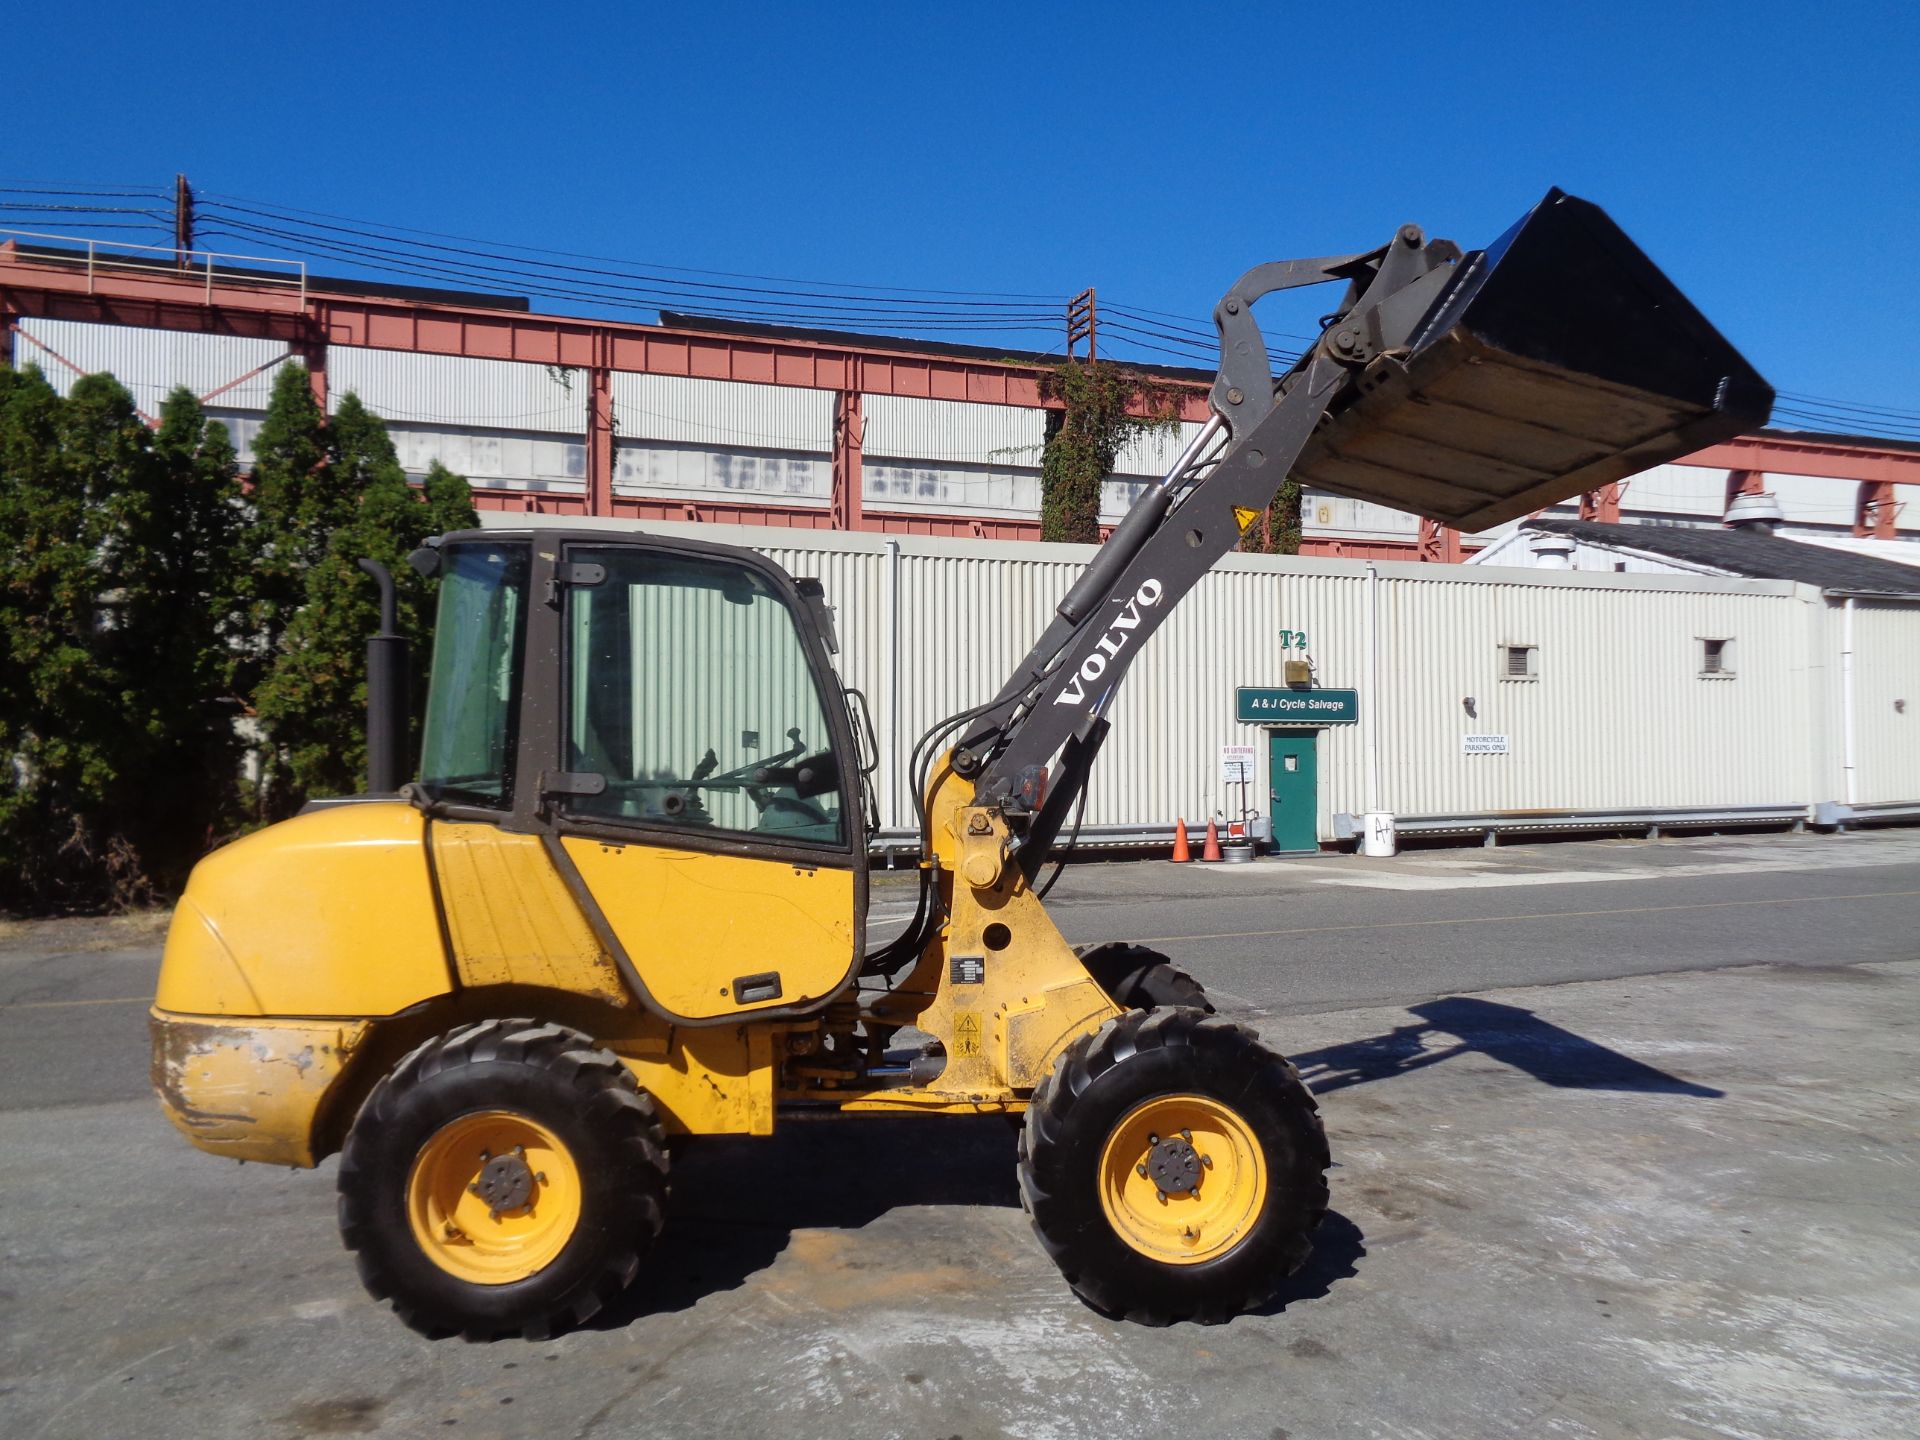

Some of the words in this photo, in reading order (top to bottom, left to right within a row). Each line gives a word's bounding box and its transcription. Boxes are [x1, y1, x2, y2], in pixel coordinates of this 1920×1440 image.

[1053, 579, 1162, 706] VOLVO
[1279, 629, 1307, 649] T2
[1252, 699, 1260, 708] A
[1263, 699, 1269, 708] &
[1271, 699, 1277, 708] J
[1279, 699, 1306, 711] Cycle
[1308, 699, 1344, 712] Salvage
